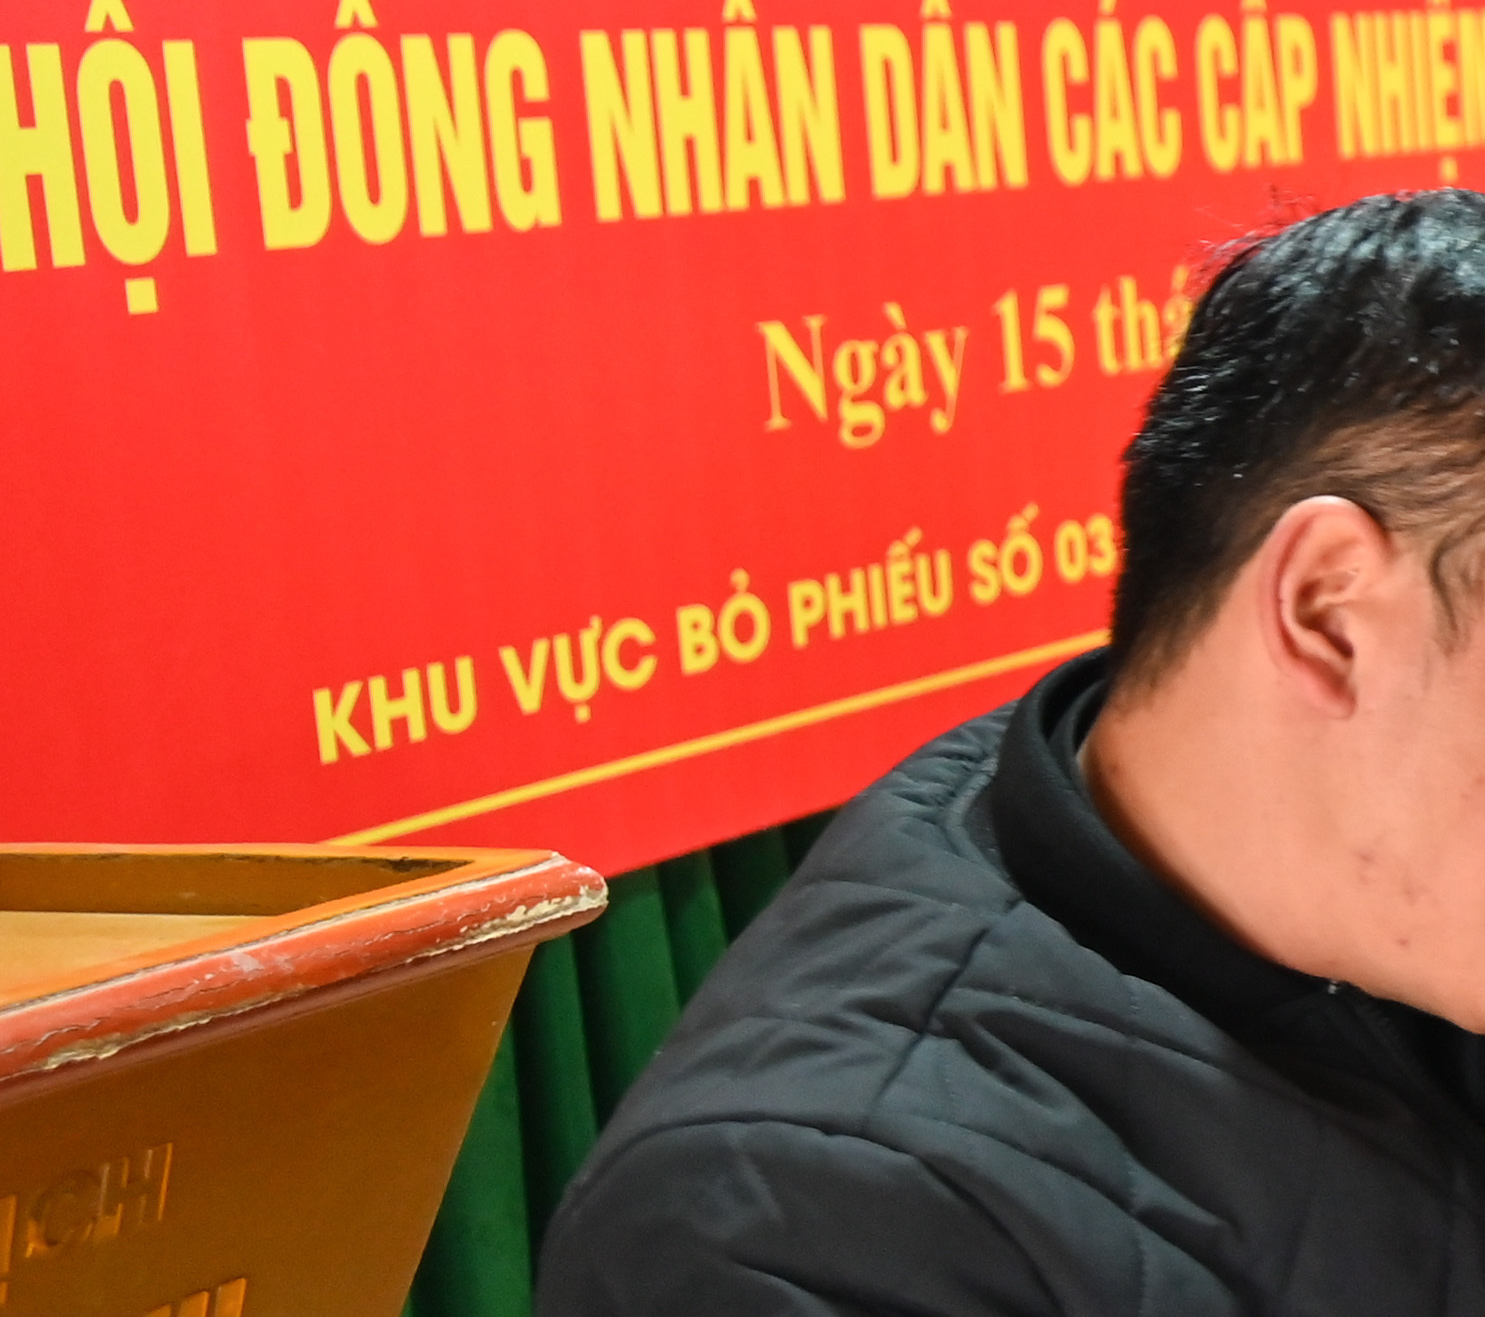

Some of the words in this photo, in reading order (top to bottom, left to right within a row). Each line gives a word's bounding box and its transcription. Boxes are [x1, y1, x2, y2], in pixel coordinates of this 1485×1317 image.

[756, 302, 969, 450] Ngày
[996, 284, 1076, 392] 15
[1092, 264, 1193, 377] thá
[312, 656, 478, 765] KHU
[498, 616, 657, 722] VỰC
[676, 566, 771, 675] BỎ
[788, 525, 953, 647] PHIẾU
[967, 501, 1044, 605] SỐ
[1054, 514, 1118, 584] 03
